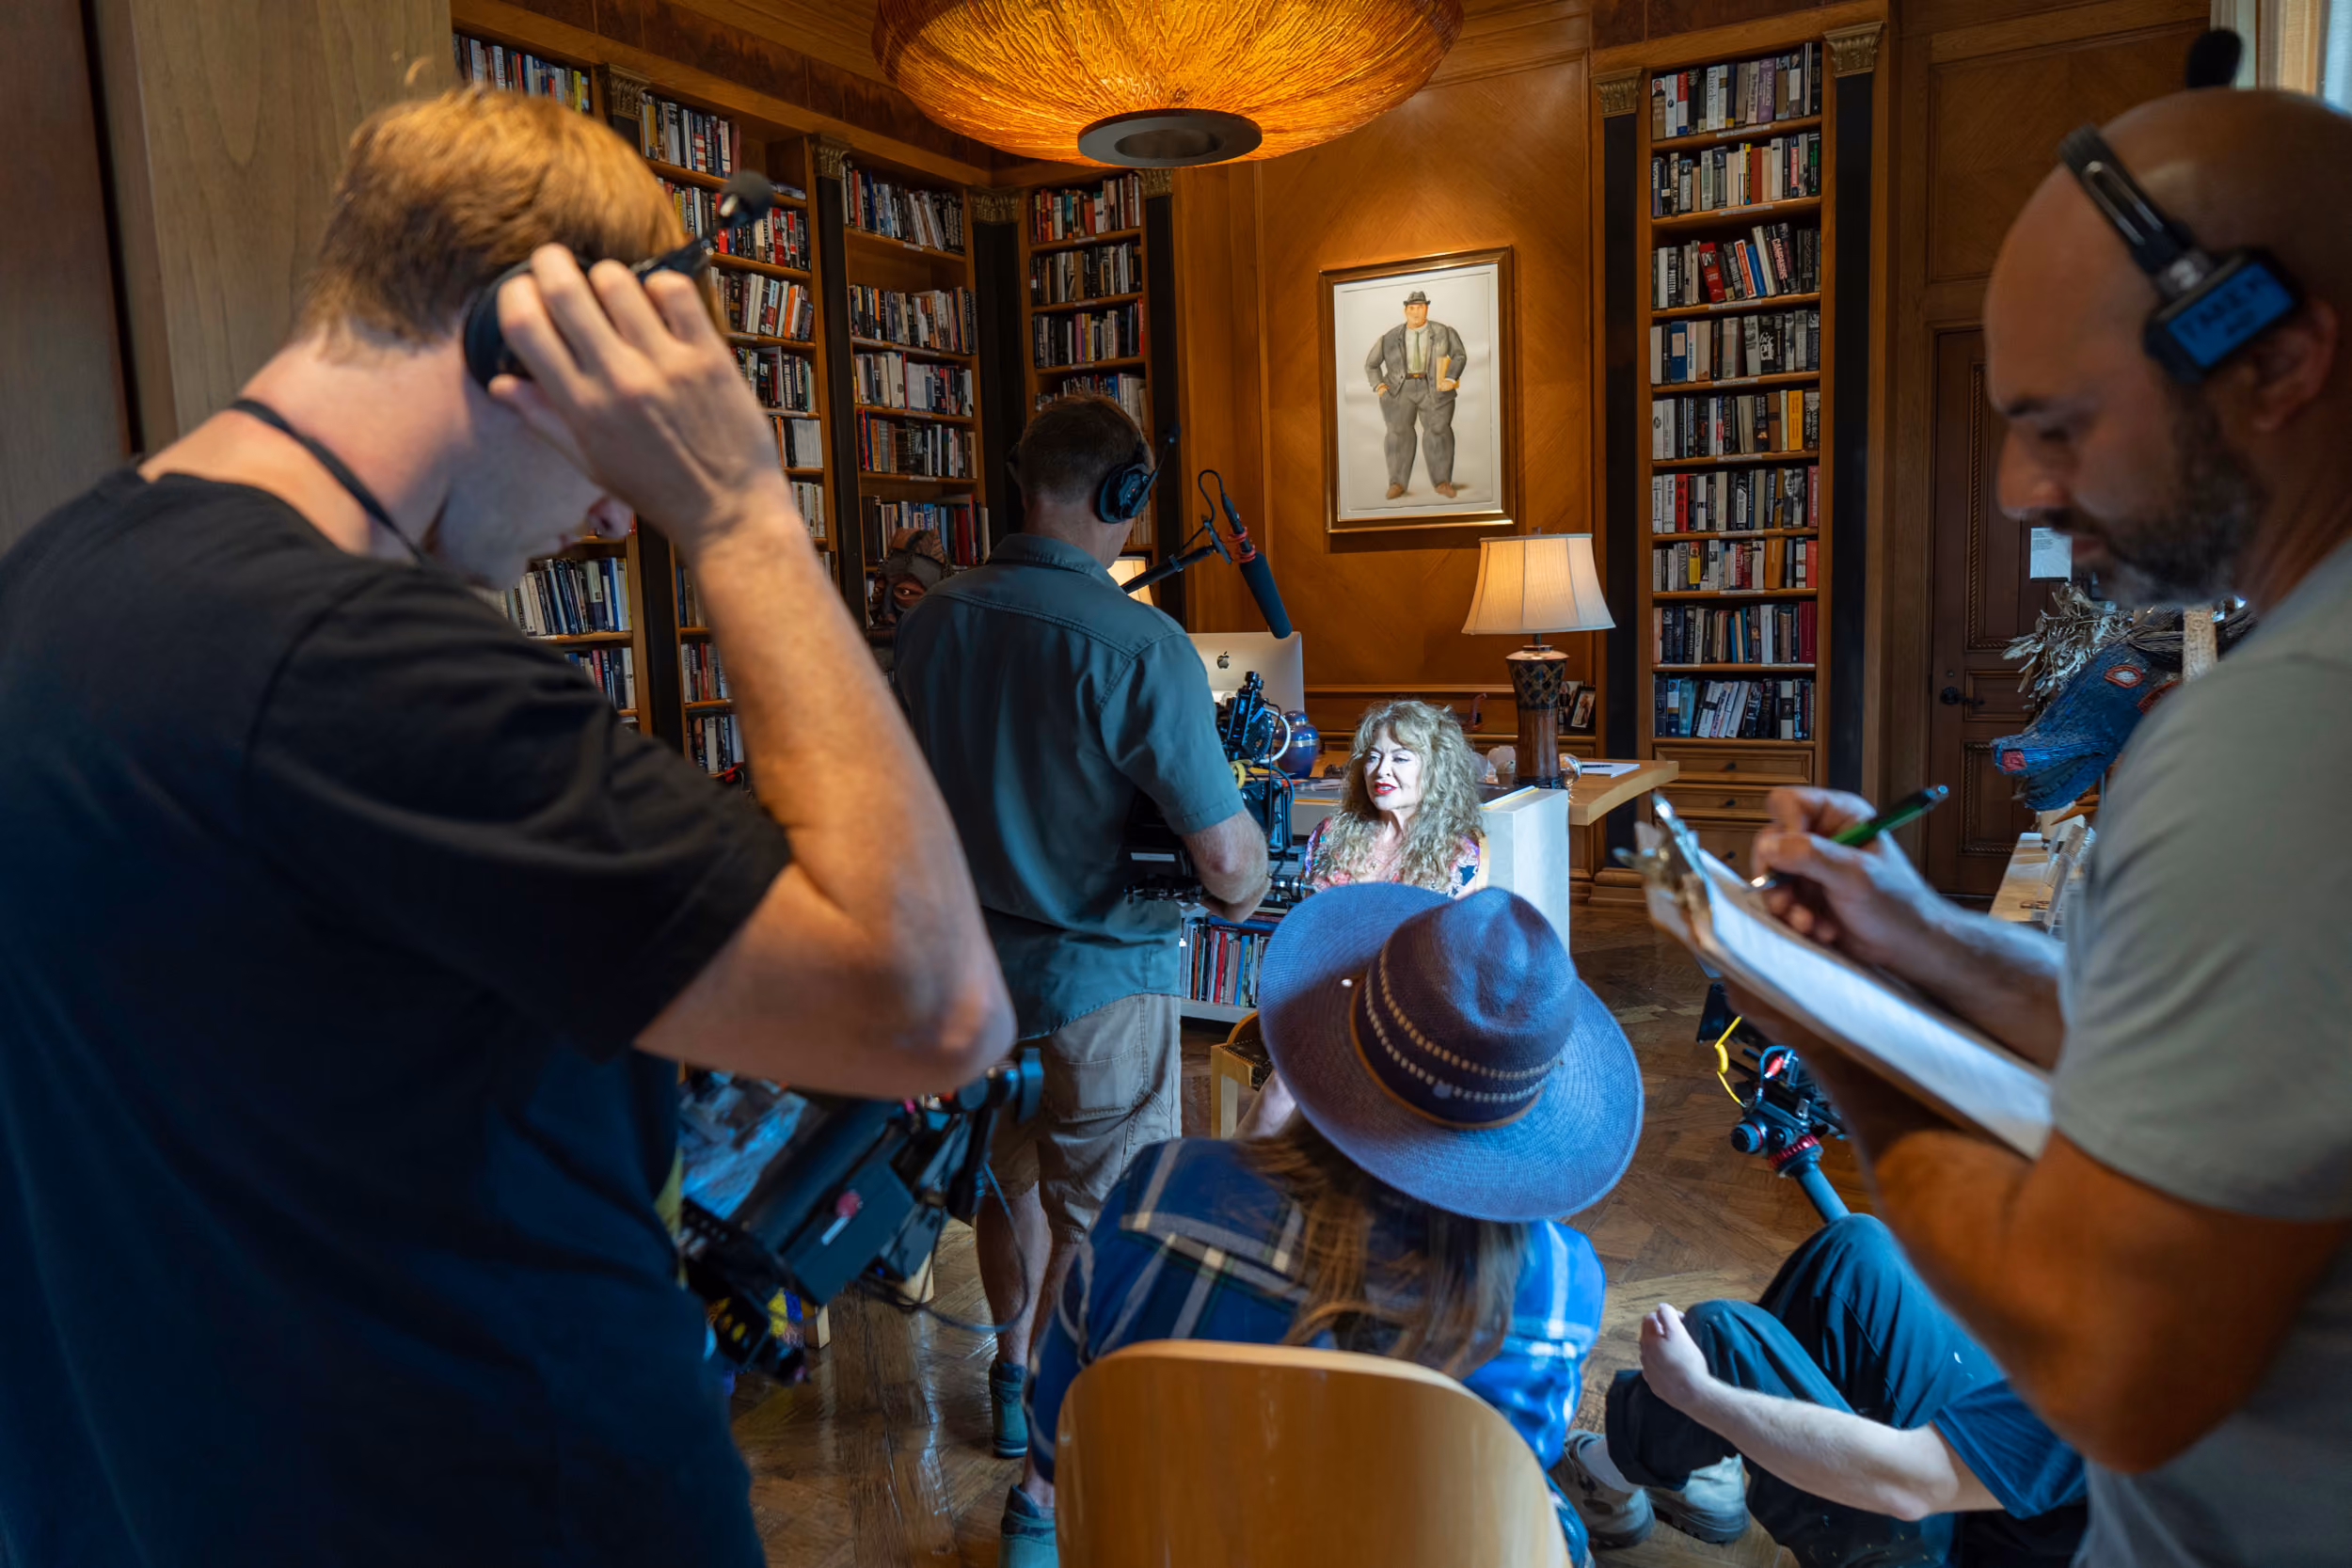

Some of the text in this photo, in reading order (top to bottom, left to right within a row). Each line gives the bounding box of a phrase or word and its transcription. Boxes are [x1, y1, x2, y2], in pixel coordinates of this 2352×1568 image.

[1708, 71, 1717, 101] Dutch
[1677, 481, 1686, 513] MAO
[1679, 548, 1688, 572] TITAN
